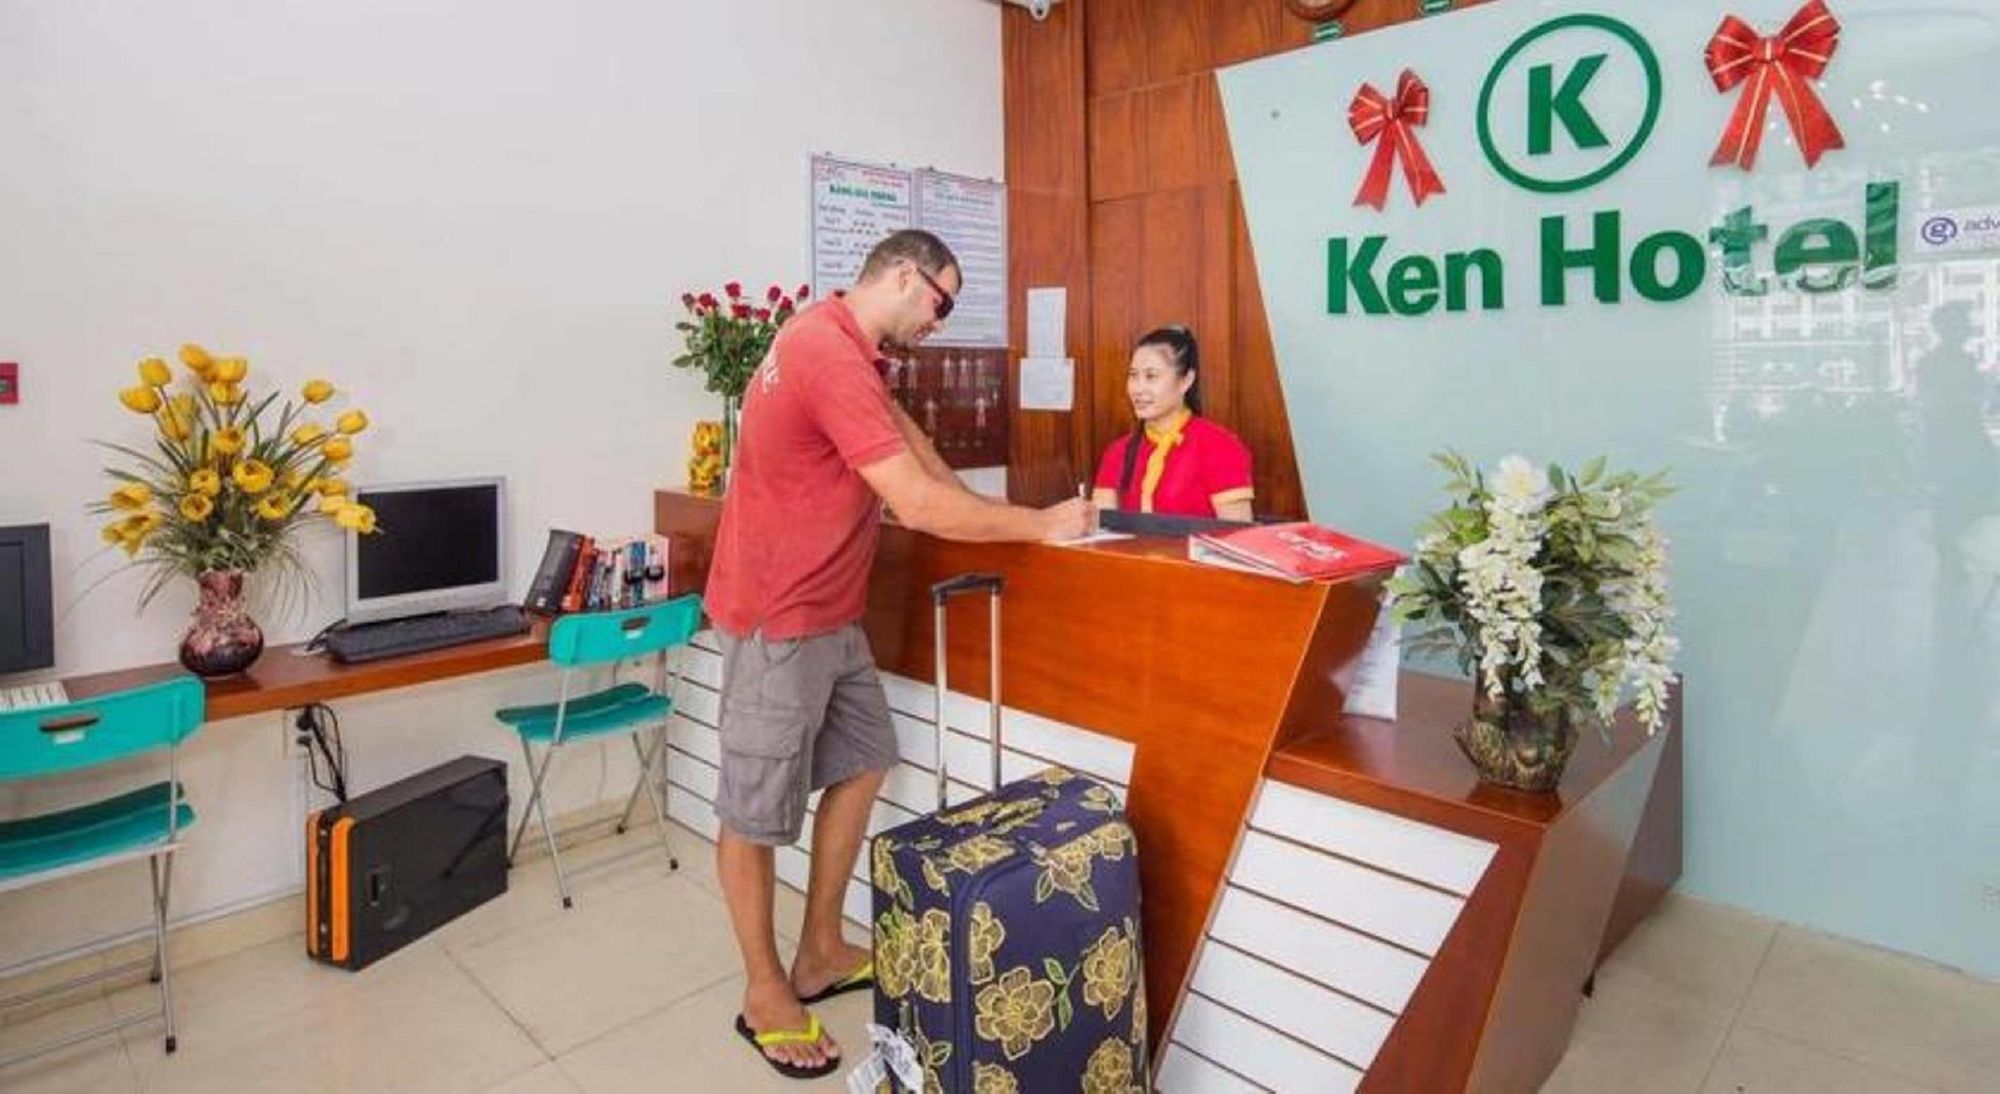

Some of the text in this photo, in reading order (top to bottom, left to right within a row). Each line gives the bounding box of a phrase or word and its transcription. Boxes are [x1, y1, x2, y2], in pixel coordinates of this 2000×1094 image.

[1527, 53, 1610, 157] K
[1327, 181, 1900, 316] Ken Hotel
